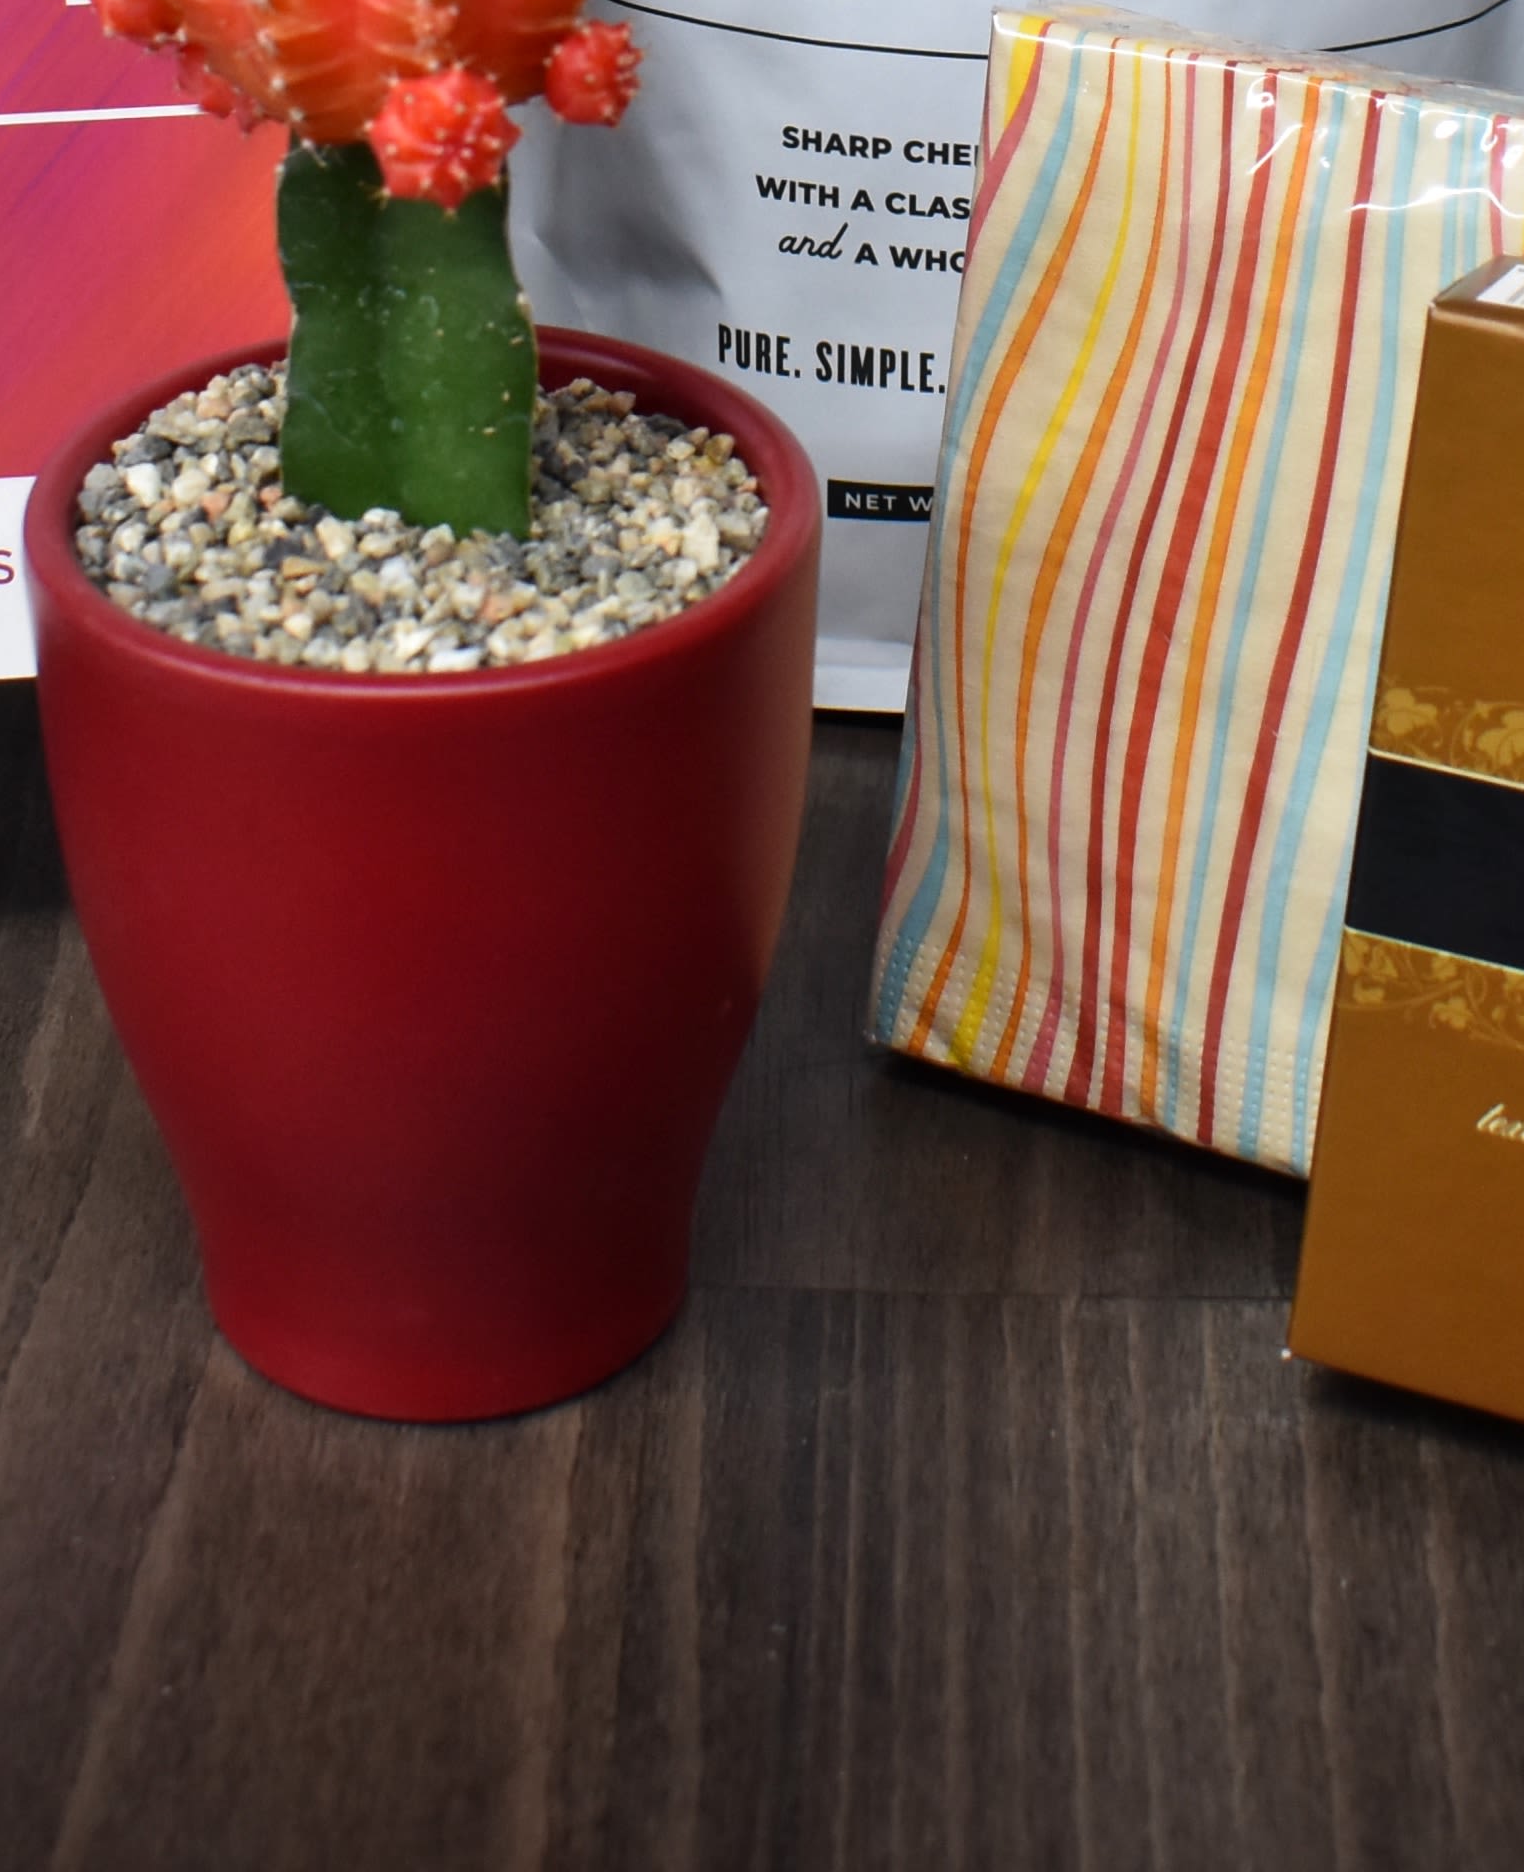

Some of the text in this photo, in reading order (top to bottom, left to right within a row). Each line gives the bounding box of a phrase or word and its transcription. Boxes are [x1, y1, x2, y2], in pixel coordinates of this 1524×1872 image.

[781, 125, 979, 168] SHARP CHE
[755, 174, 840, 209] WITH
[850, 189, 875, 213] A
[778, 222, 849, 260] and
[854, 242, 879, 266] A
[717, 323, 947, 394] PURE. SIMPLE.
[844, 491, 897, 511] NET
